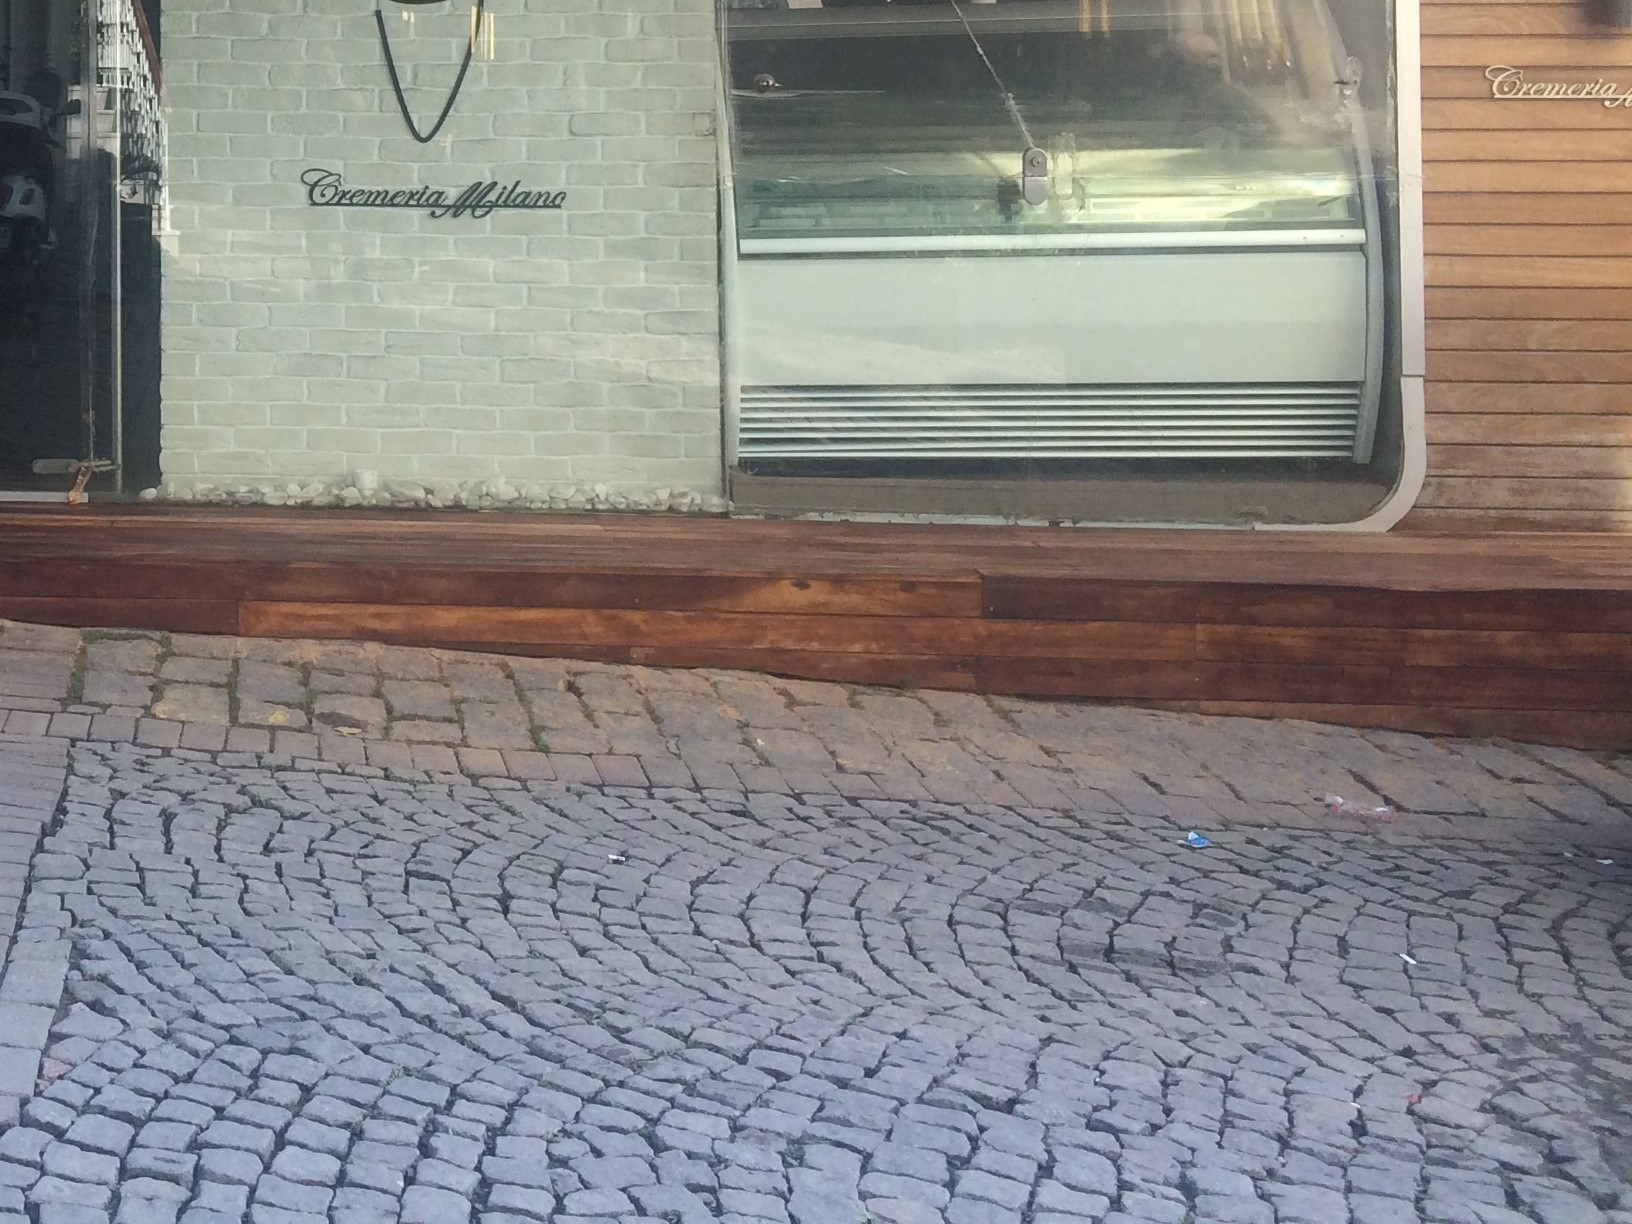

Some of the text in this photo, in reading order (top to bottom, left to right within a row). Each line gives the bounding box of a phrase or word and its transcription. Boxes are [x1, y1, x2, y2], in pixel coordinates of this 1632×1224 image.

[1484, 65, 1620, 98] Cremeria
[300, 168, 568, 219] Cremeria Milano
